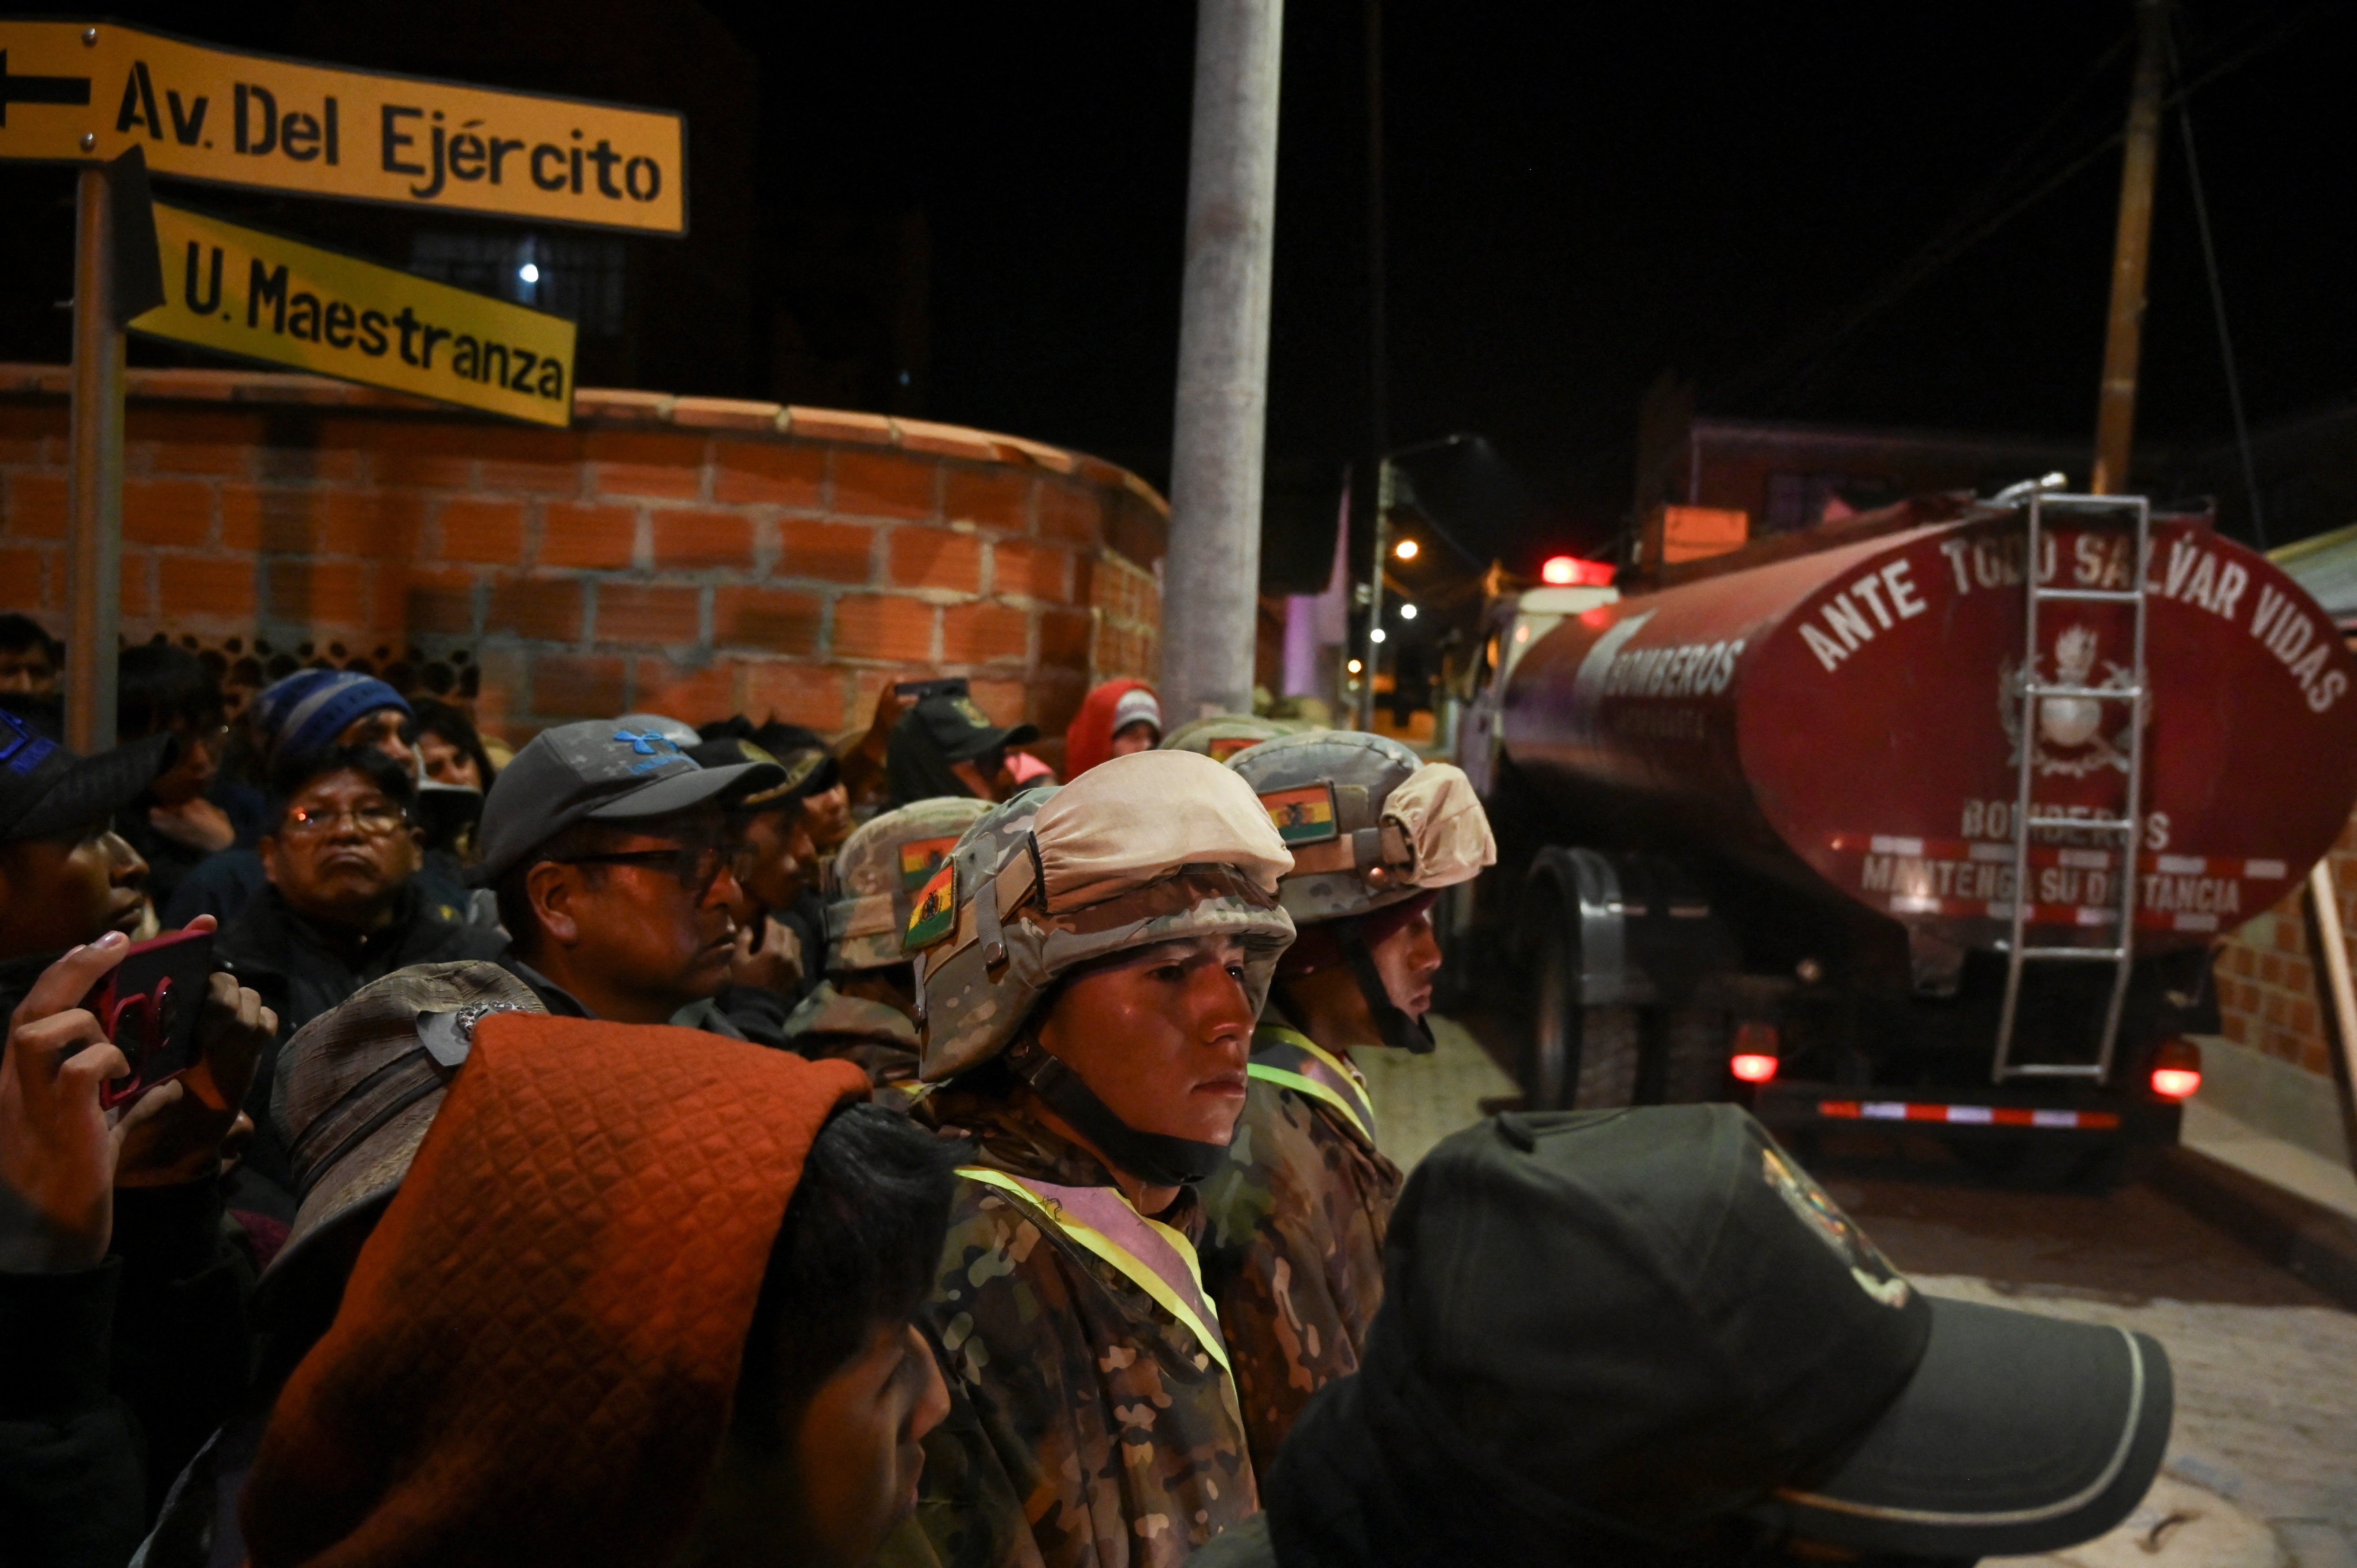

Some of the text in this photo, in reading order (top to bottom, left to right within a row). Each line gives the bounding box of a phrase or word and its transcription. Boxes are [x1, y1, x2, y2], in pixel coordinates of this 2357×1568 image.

[116, 60, 662, 203] Av. Del Ejército
[185, 241, 564, 401] U. Maestranza
[1605, 638, 1746, 697] BOMBEROS
[1798, 559, 1926, 672] ANTE
[2250, 583, 2348, 713] VIDAS
[2040, 867, 2080, 904] SU
[2086, 871, 2240, 914] DTANCIA
